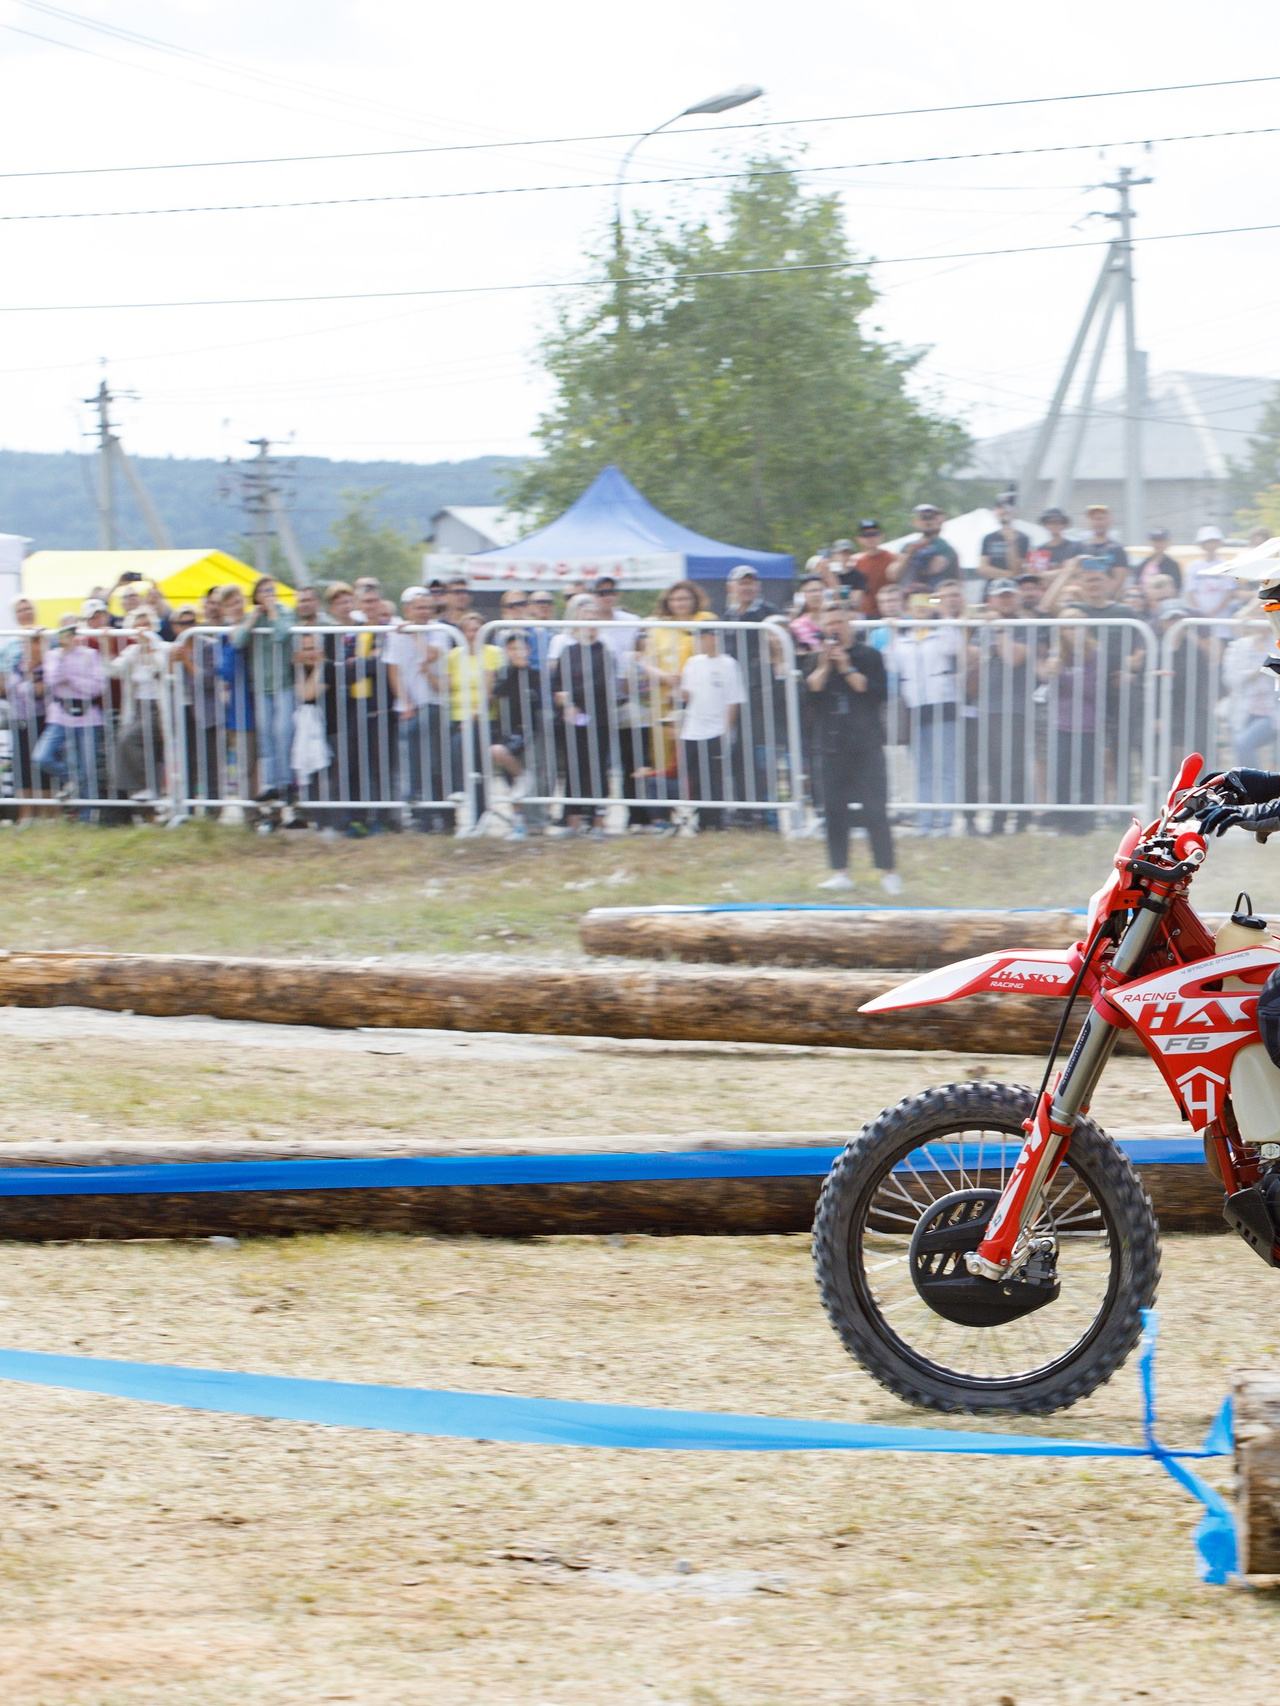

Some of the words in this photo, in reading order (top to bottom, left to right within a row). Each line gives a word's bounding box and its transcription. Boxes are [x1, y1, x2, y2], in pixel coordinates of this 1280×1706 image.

[1187, 961, 1214, 973] STROKE
[998, 971, 1065, 984] HASKY
[989, 981, 1025, 989] RACING
[1122, 991, 1177, 1003] RACING
[1164, 1036, 1210, 1052] F6
